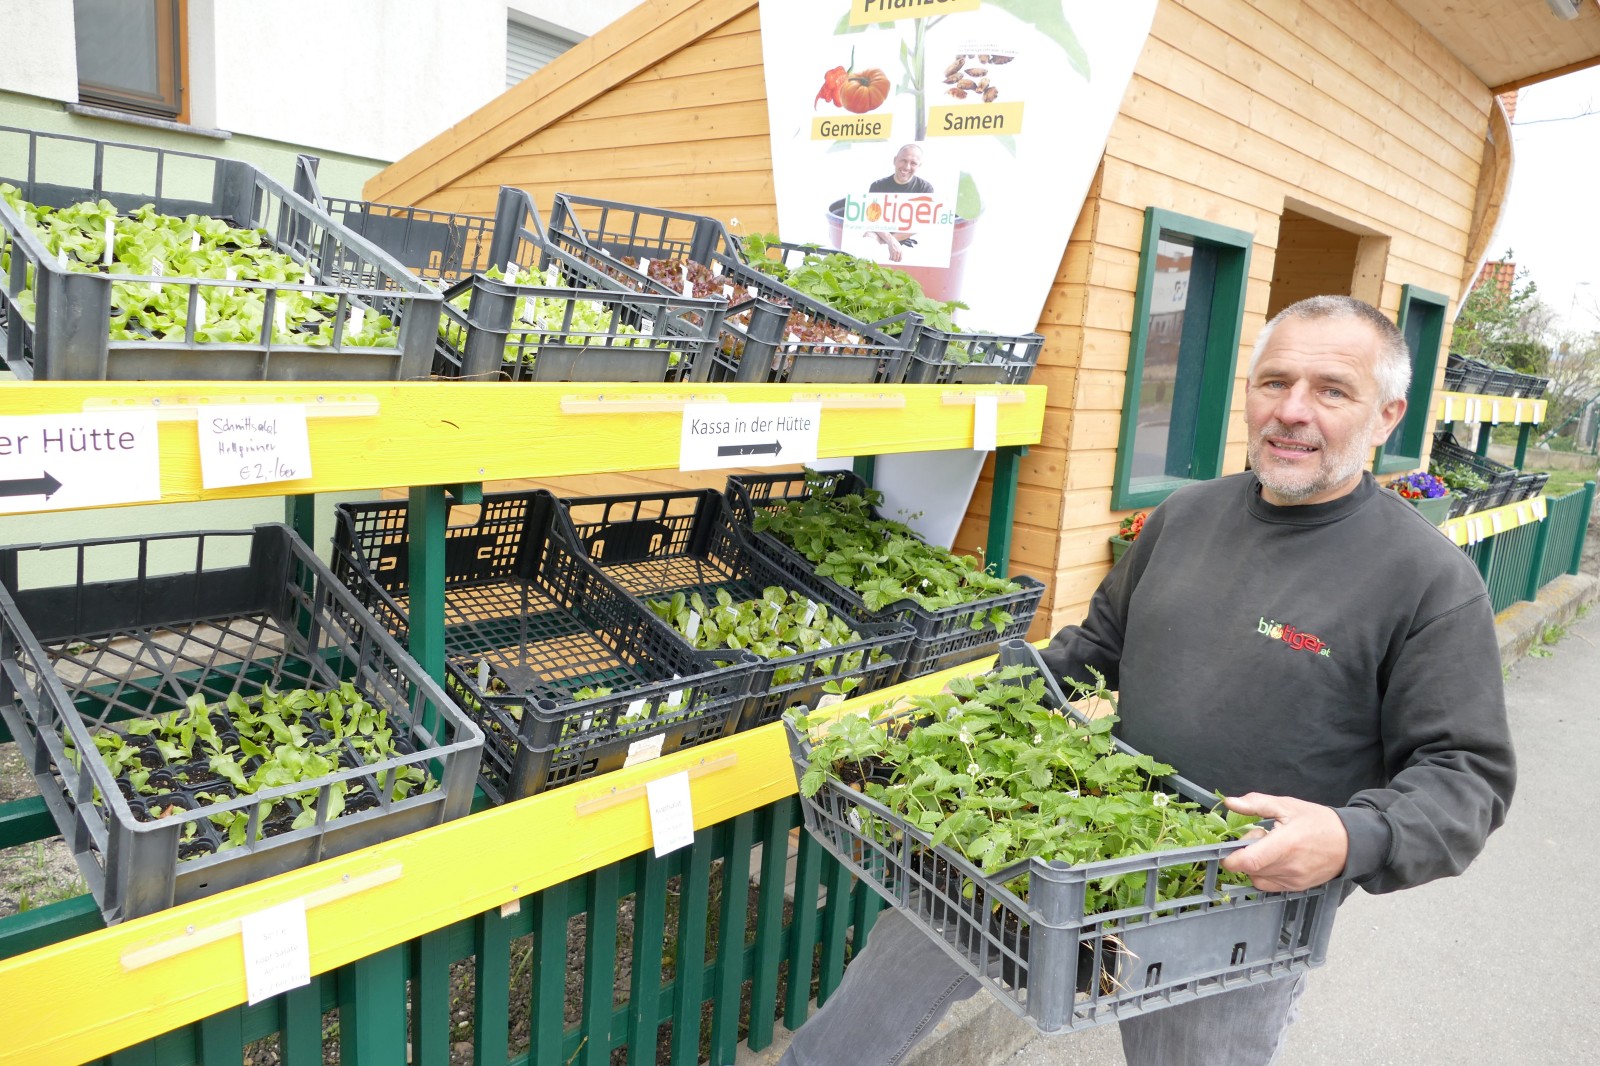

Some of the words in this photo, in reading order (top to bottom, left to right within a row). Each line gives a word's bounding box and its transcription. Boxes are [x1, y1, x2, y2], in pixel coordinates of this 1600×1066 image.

[820, 118, 882, 138] Gemüse
[943, 112, 1004, 131] Samen
[691, 418, 730, 435] Kassa
[735, 417, 747, 433] in
[751, 416, 773, 433] der
[776, 416, 811, 432] Hütte
[43, 427, 135, 453] Hütte
